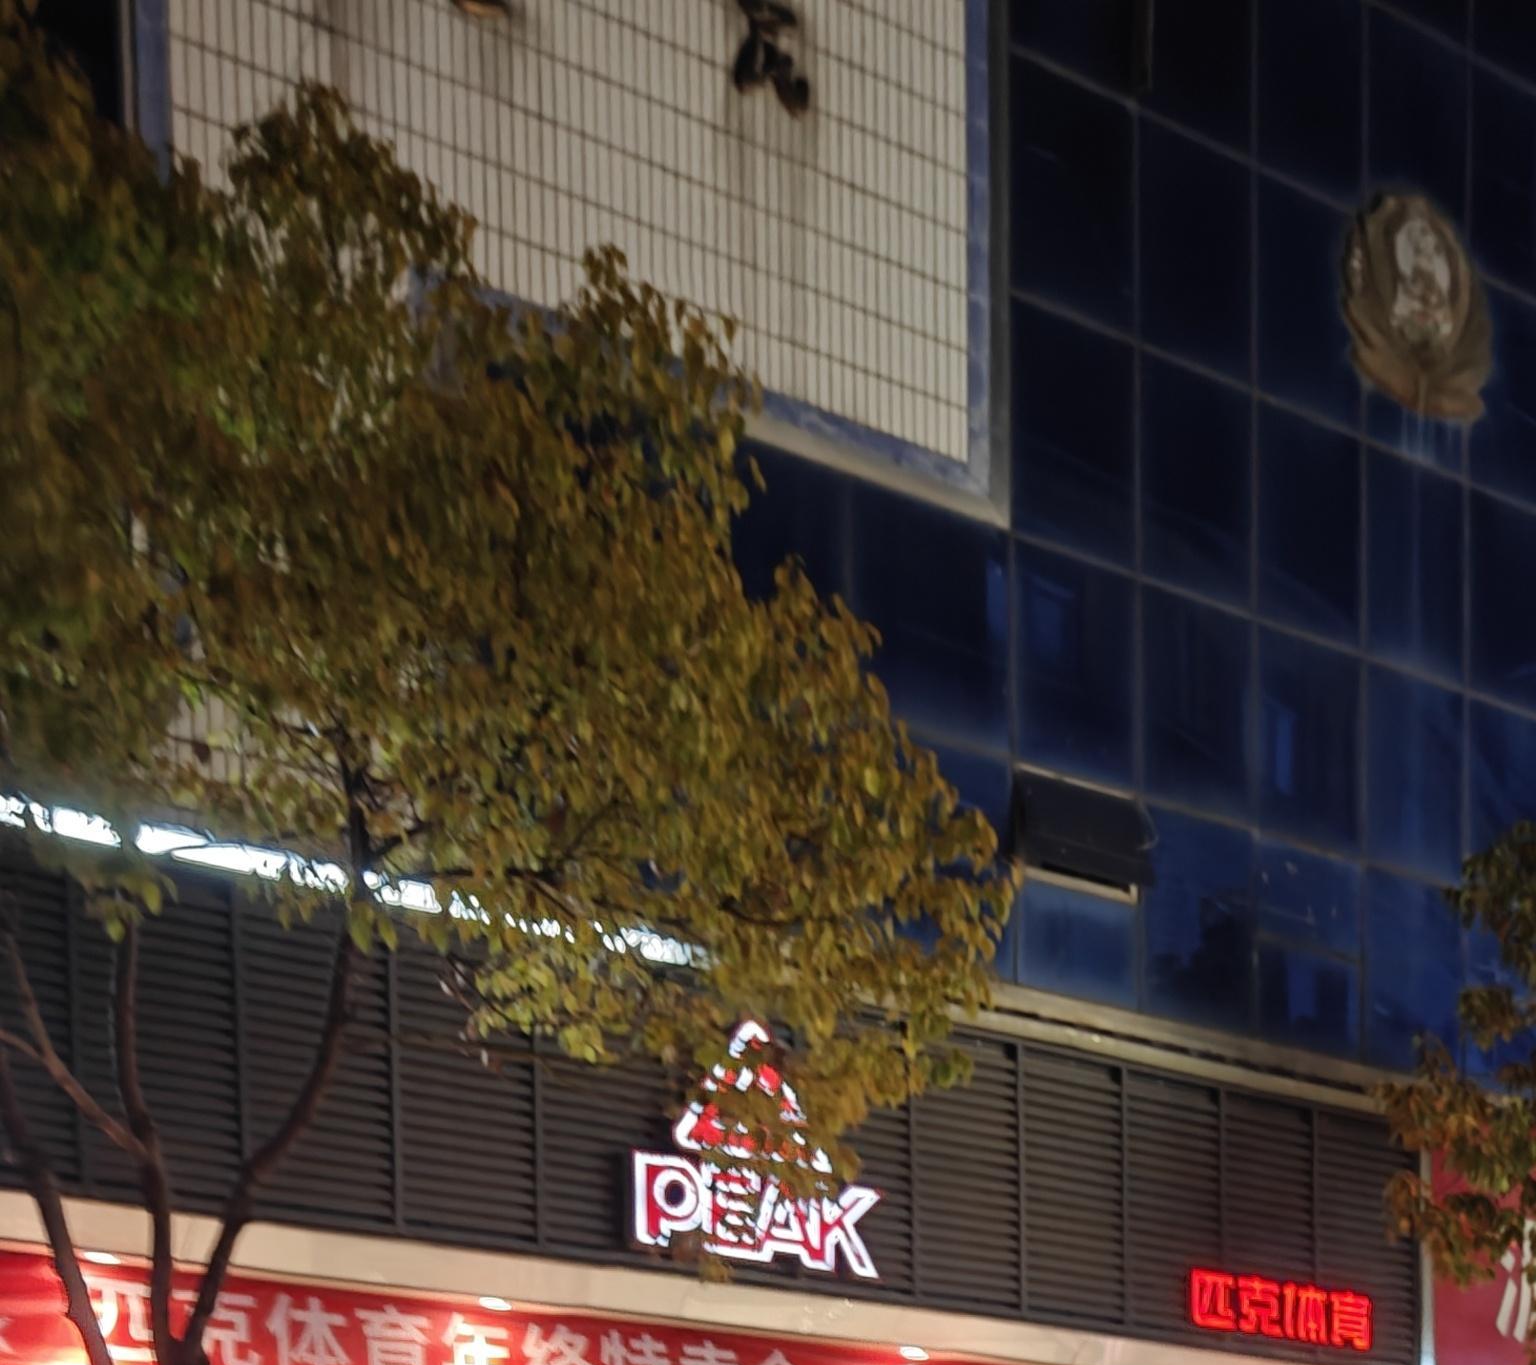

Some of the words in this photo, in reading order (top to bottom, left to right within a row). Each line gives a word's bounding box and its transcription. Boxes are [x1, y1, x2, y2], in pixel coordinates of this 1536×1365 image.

[633, 1151, 880, 1279] PEAK
[1190, 1267, 1372, 1352] 匹克体育
